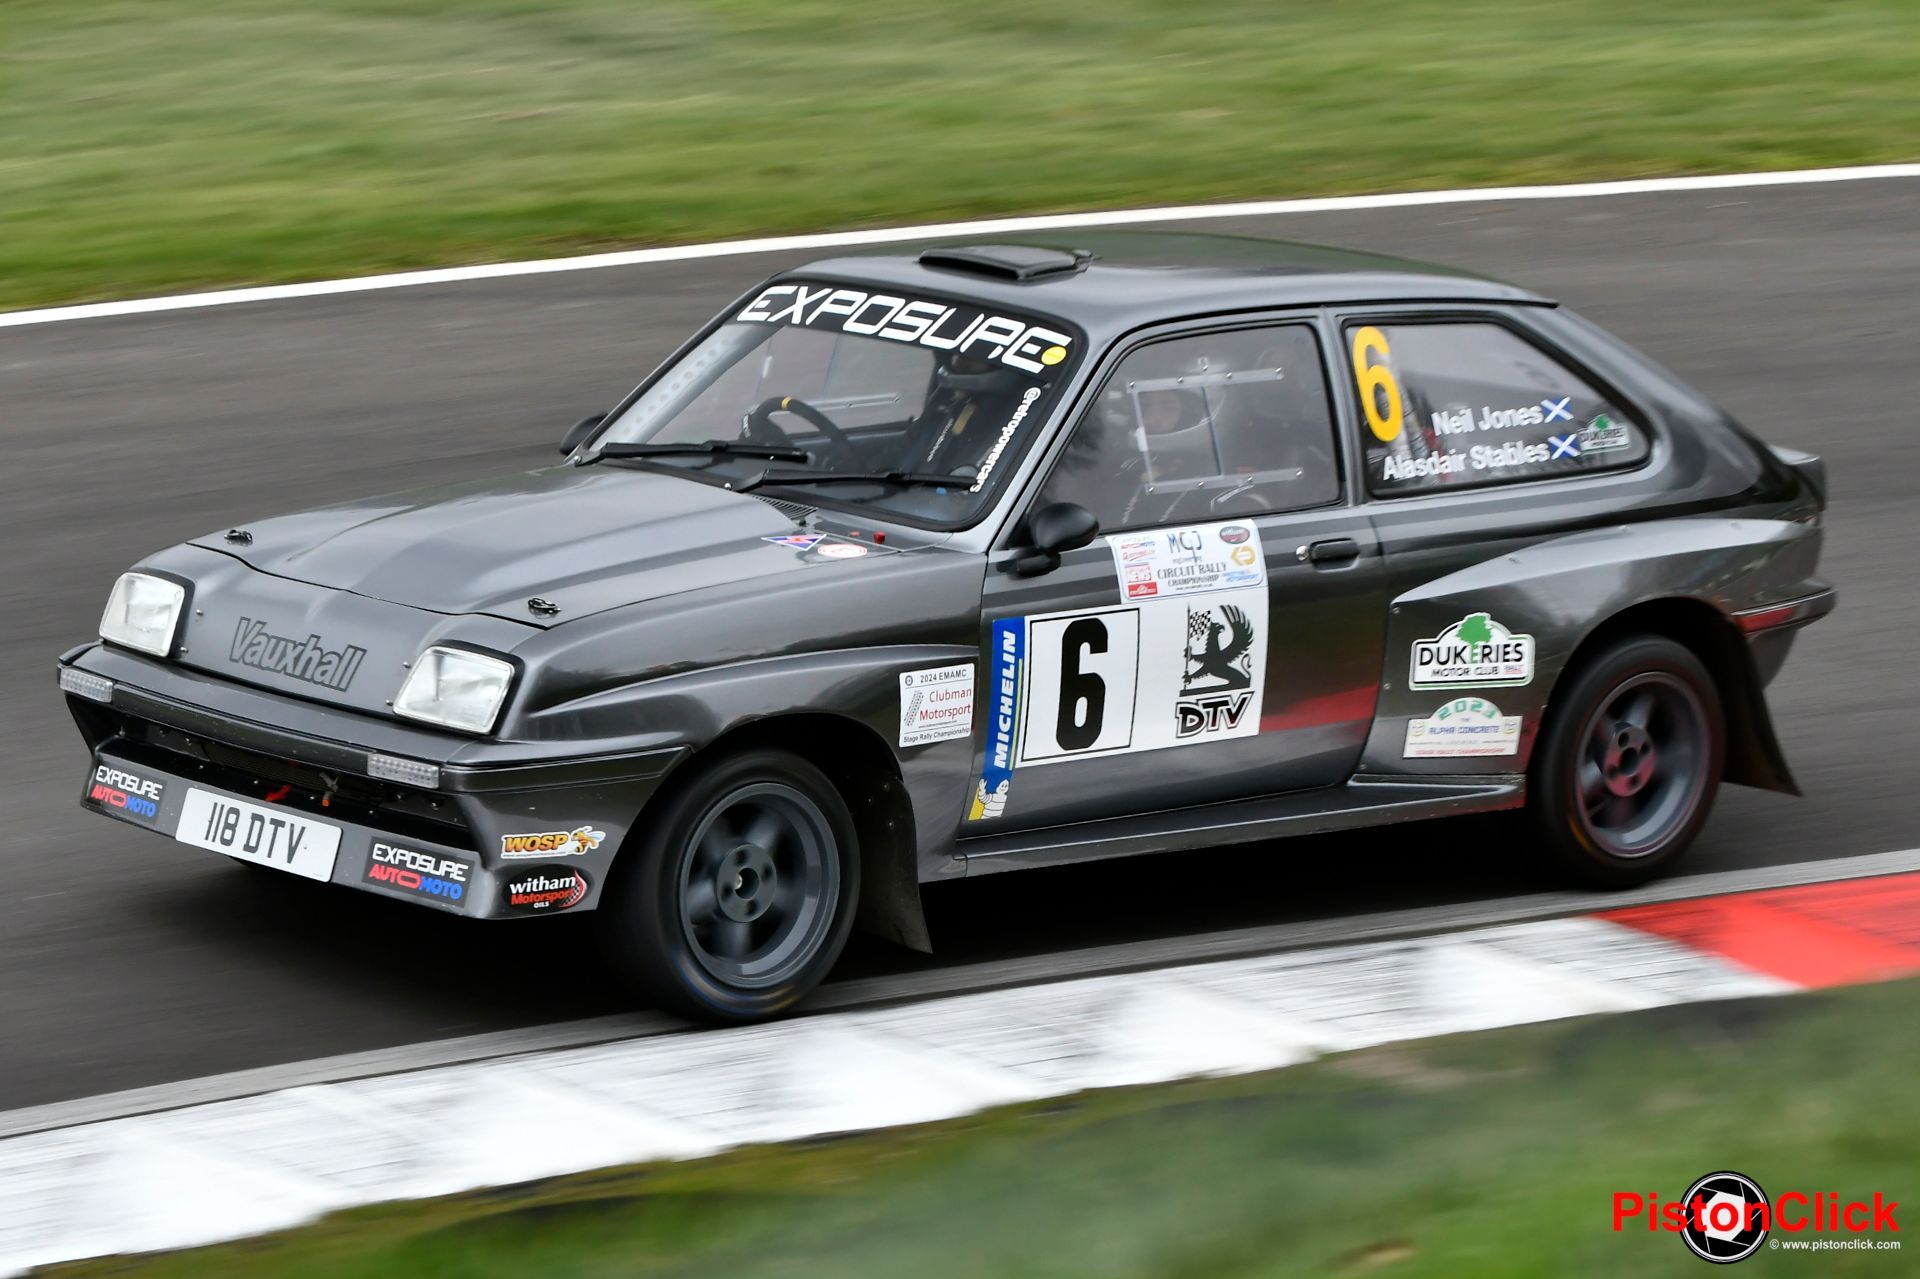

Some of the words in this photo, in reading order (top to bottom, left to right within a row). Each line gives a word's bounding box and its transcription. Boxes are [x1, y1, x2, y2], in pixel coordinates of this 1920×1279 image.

[737, 285, 1073, 374] EXPOSURE
[1352, 325, 1403, 442] 6
[1431, 408, 1475, 437] Neil
[1478, 404, 1545, 431] Jones
[1383, 449, 1466, 482] Alasdair
[1469, 441, 1551, 471] Stables
[1157, 565, 1195, 580] CIRCUIT
[1198, 562, 1227, 576] RALLY
[229, 616, 367, 692] Vauxhall
[1420, 643, 1523, 666] DUKERIES
[920, 673, 937, 684] 2024
[939, 669, 967, 681] EMAMC
[1056, 617, 1108, 751] 6
[1431, 666, 1470, 678] MOTOR
[1475, 666, 1499, 676] CLUB
[929, 688, 972, 703] Clubman
[994, 630, 1016, 770] MICHELIN
[920, 704, 971, 721] Motorsport
[1175, 690, 1255, 739] DTV
[920, 733, 933, 741] Rally
[934, 727, 970, 739] Championship
[95, 765, 163, 801] EXPOSURE
[204, 802, 240, 847] 118
[242, 812, 306, 864] DTV
[504, 834, 569, 853] WOSP
[372, 843, 469, 882] EXPOSURE
[509, 875, 576, 894] witham
[511, 888, 575, 905] Motorsport
[533, 901, 550, 909] OILS
